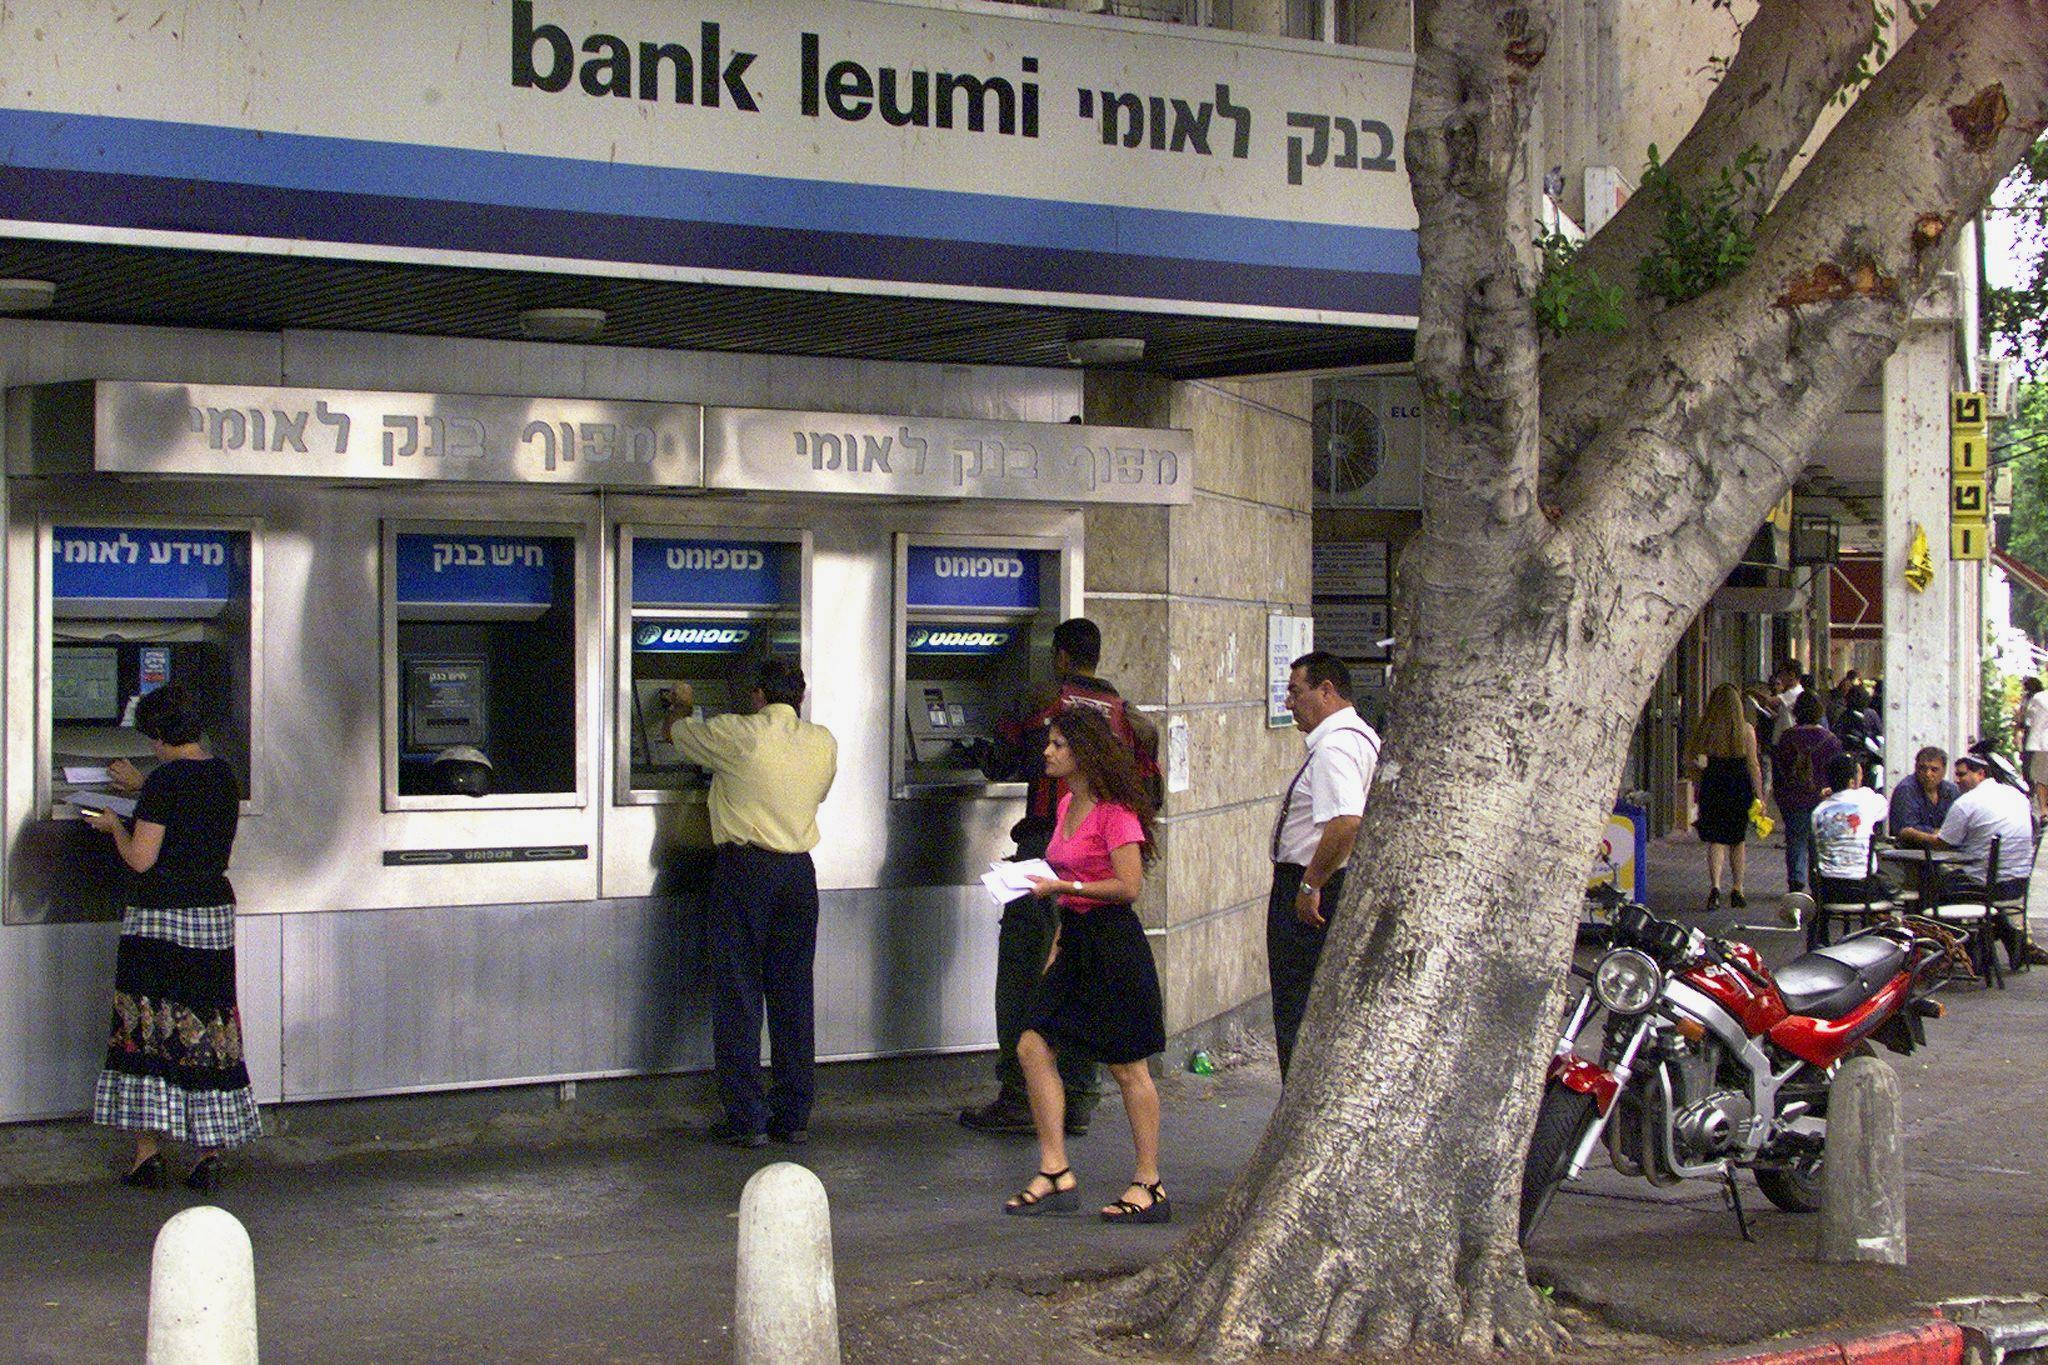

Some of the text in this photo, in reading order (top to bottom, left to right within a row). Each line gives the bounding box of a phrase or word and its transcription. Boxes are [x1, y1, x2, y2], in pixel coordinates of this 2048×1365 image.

[510, 0, 1040, 138] bank leumi
[1077, 84, 1397, 186] בנק לאומי
[189, 400, 351, 454] לאומי
[1391, 406, 1421, 418] ELC
[382, 414, 487, 467] בנק
[793, 426, 928, 474] לאומי
[953, 438, 1039, 486] בנק
[52, 533, 225, 566] מידע לאומי
[432, 543, 544, 573] חיש בנק
[666, 547, 764, 571] כספומט
[934, 556, 1024, 578] כספומט
[662, 628, 750, 644] כספומט
[928, 631, 1010, 646] כספומט
